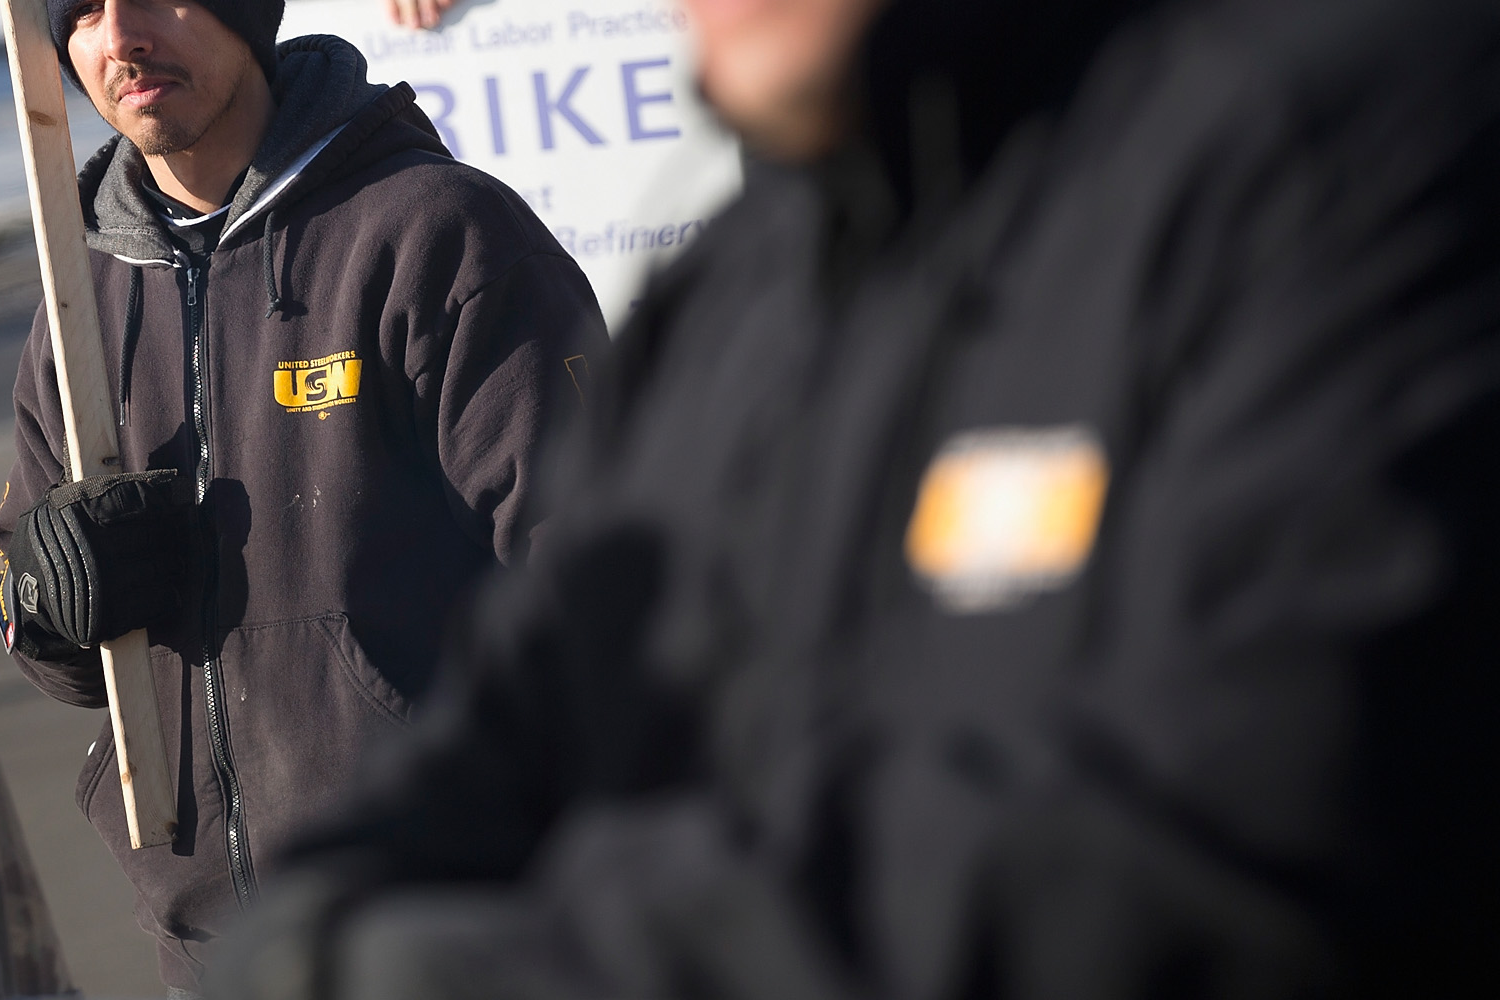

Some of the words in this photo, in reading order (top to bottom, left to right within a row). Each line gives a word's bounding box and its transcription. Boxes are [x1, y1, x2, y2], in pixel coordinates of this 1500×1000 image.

[470, 16, 553, 50] Labor
[567, 3, 689, 42] Practice
[413, 57, 682, 160] RIKE
[278, 361, 309, 369] UNITED
[310, 350, 356, 368] STEELWORKERS
[273, 360, 363, 407] USW
